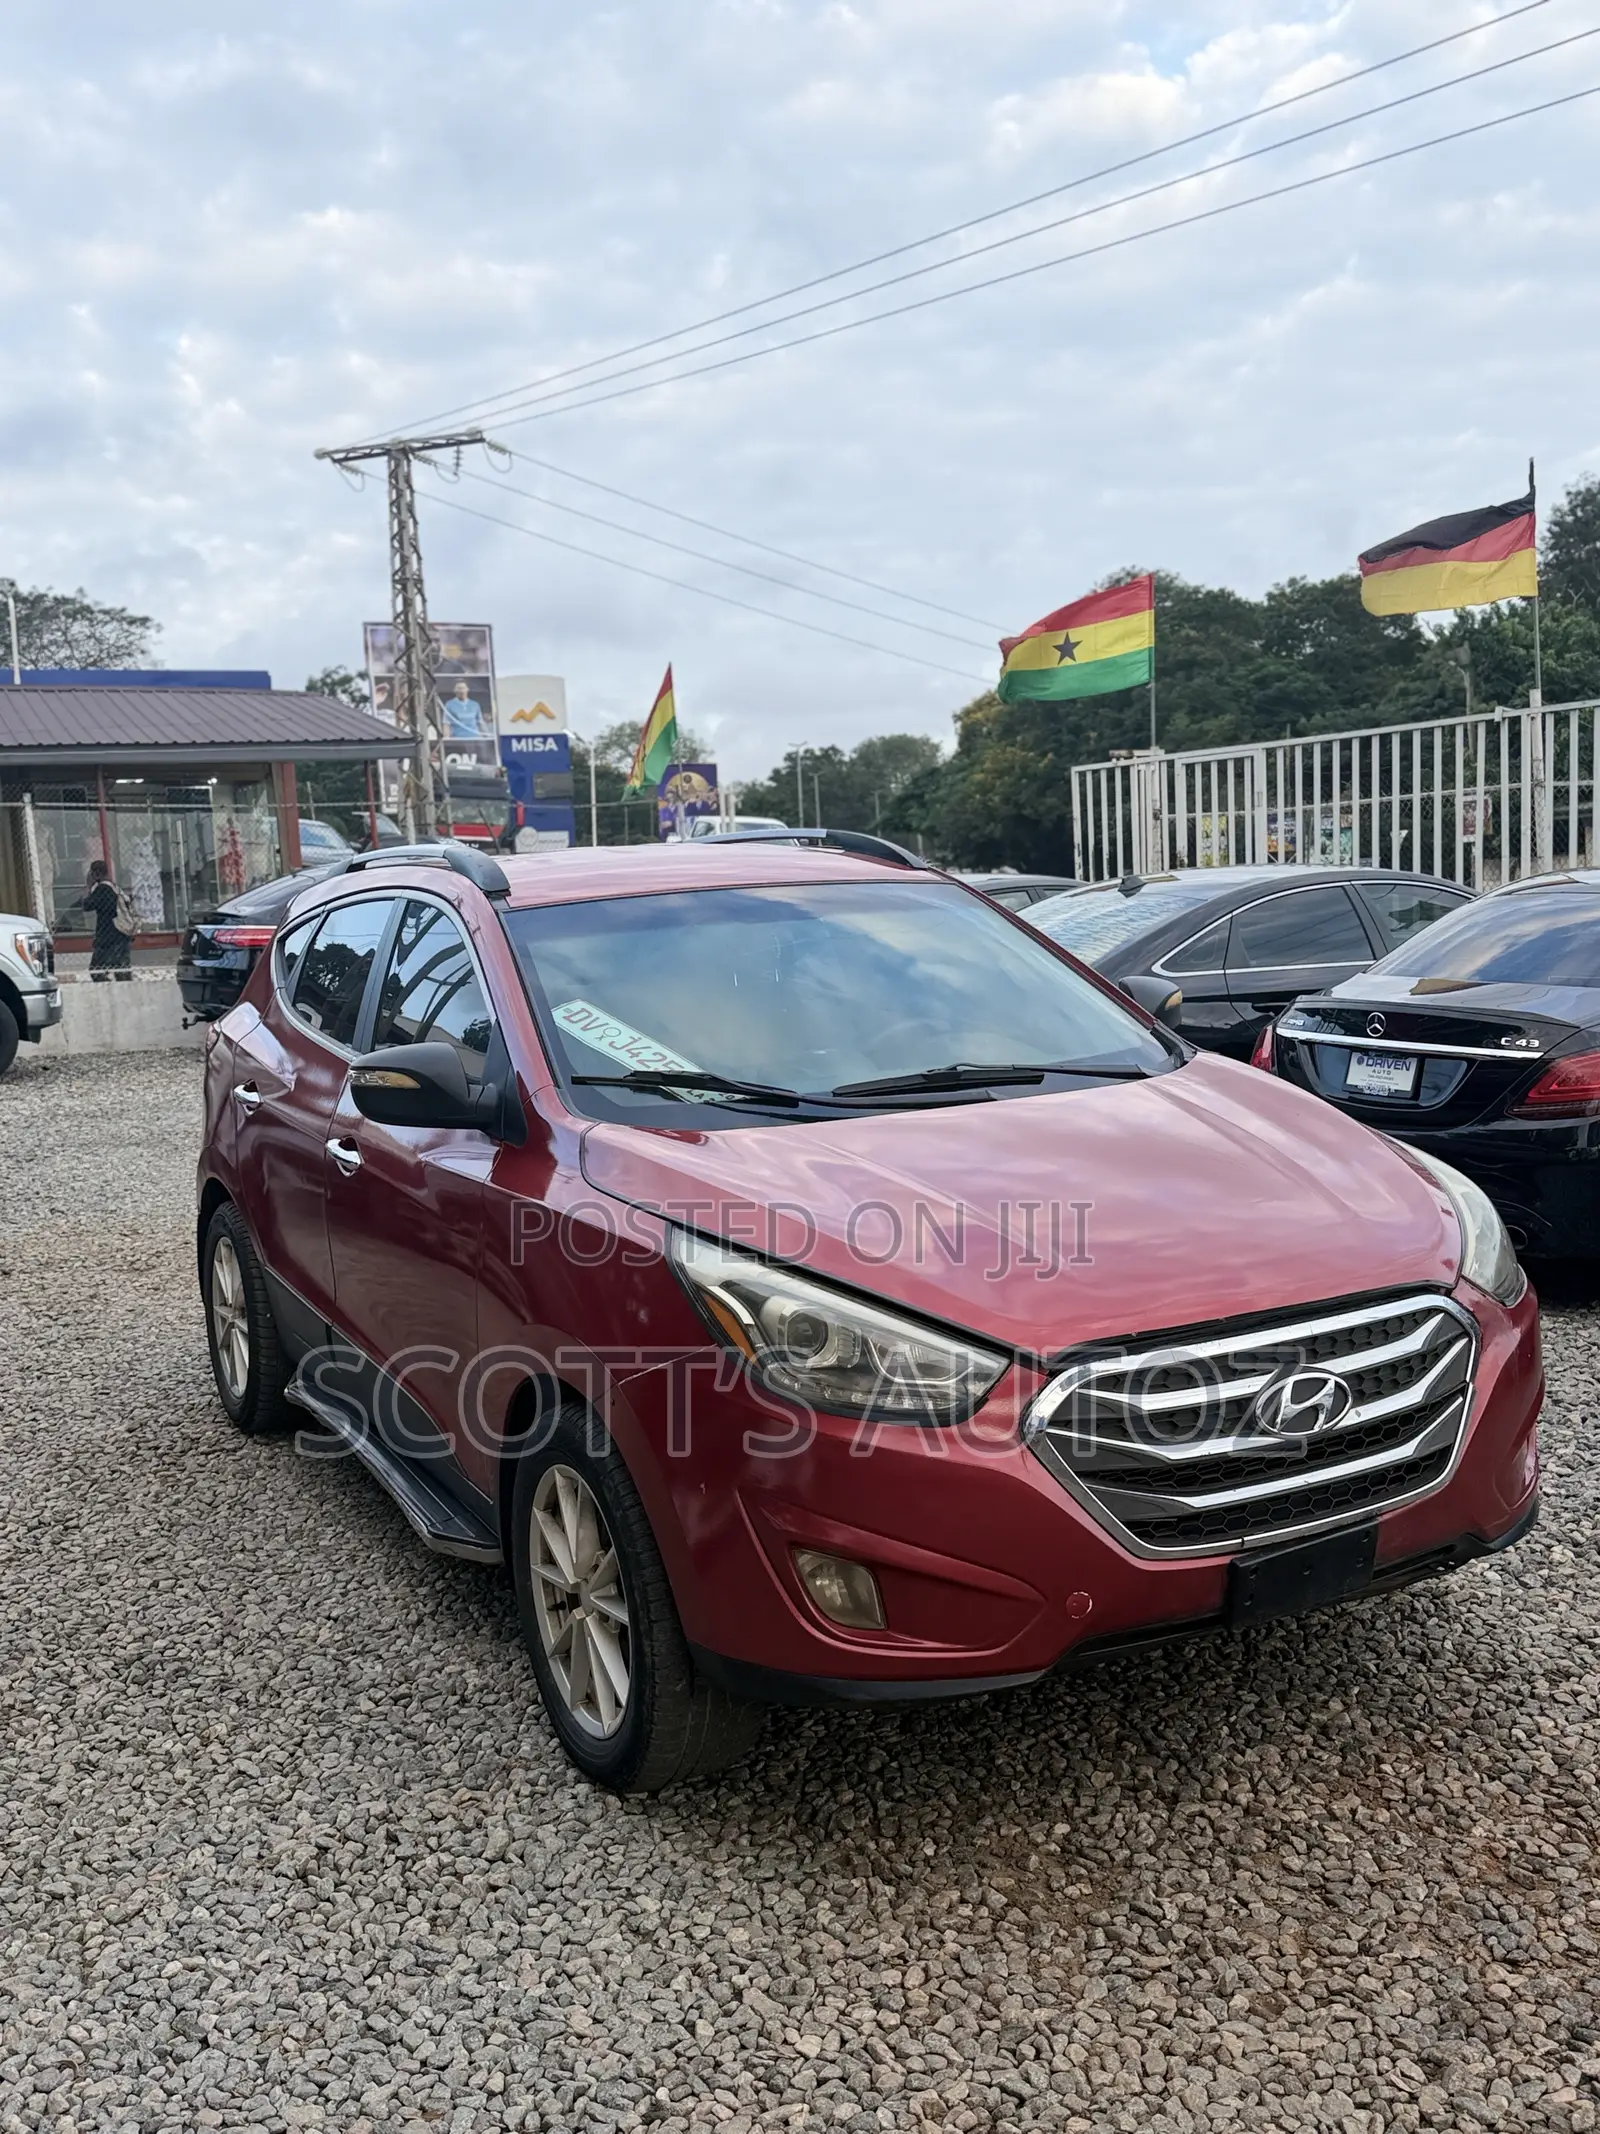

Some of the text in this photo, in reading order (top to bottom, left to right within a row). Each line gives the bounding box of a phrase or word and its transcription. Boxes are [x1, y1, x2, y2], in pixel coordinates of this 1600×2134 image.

[511, 737, 559, 752] MISA
[563, 1007, 608, 1032] DV
[1500, 1037, 1540, 1048] C 43
[1366, 1057, 1412, 1071] DRIVEN
